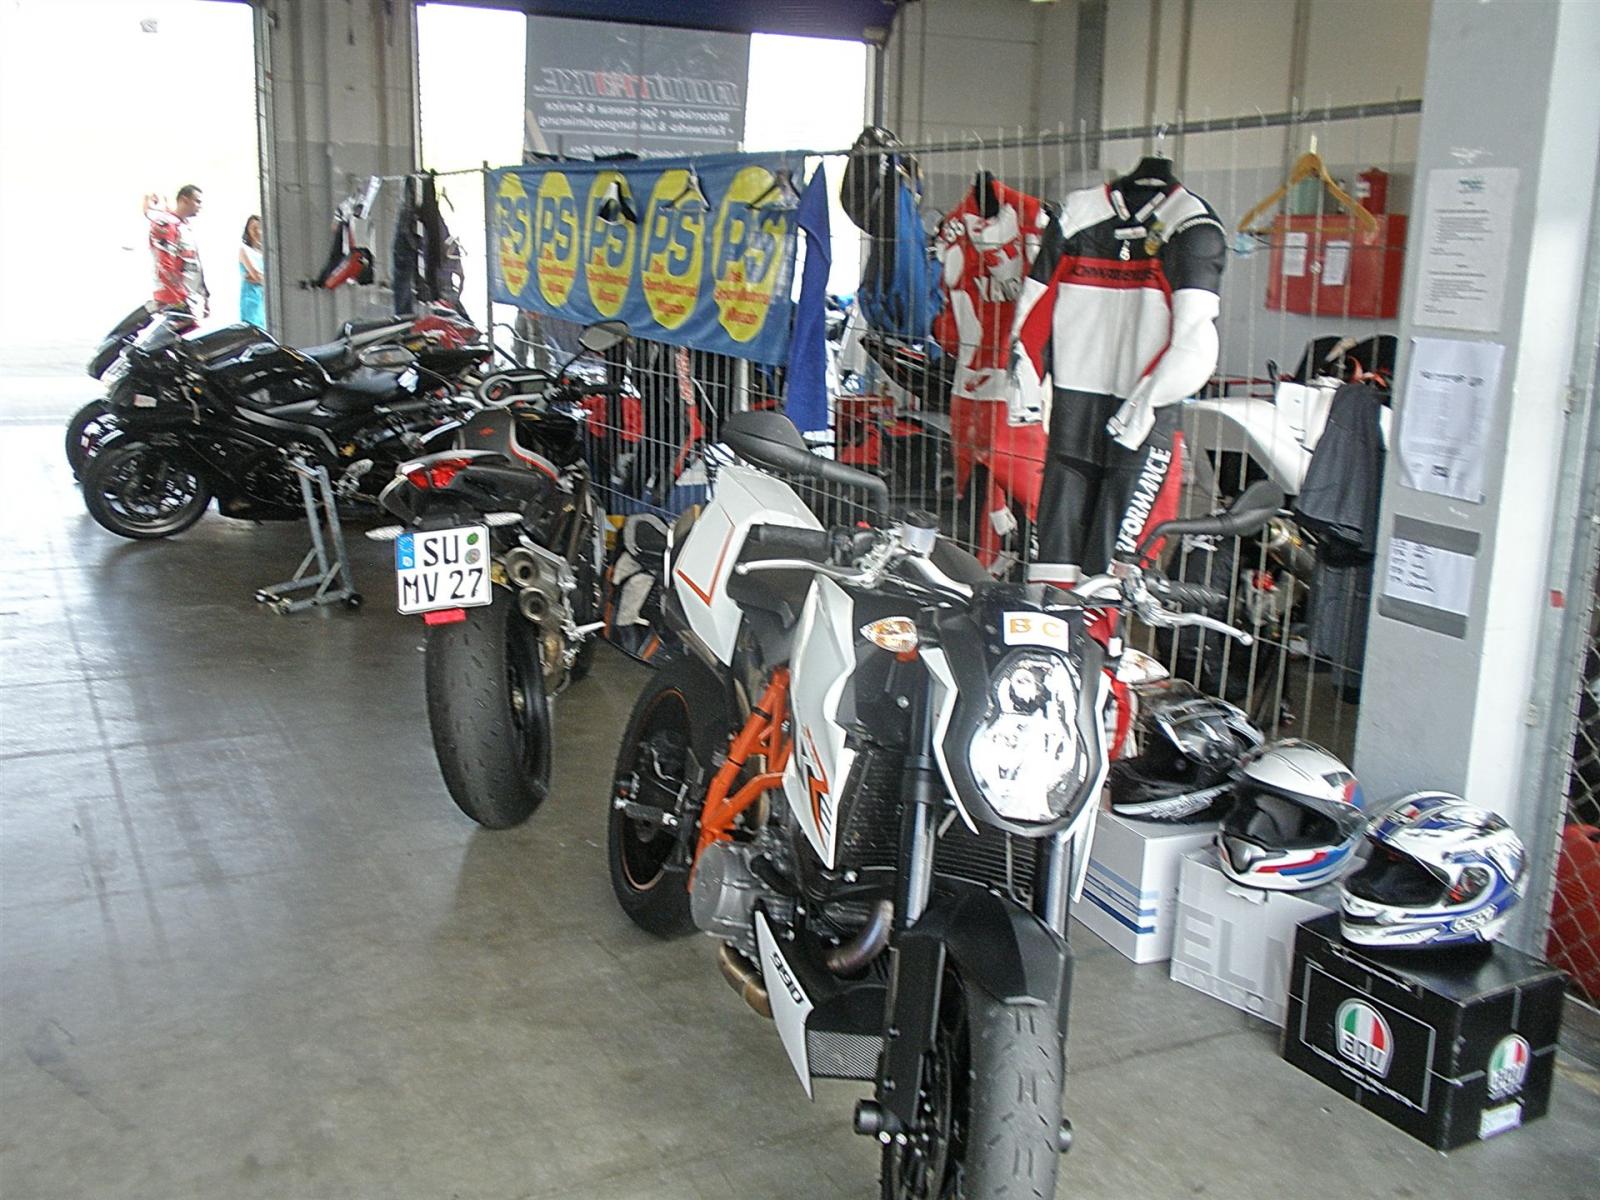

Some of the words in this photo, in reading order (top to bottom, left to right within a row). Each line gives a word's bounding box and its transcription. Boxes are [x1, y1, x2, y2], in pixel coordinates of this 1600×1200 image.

[540, 197, 575, 261] PS
[588, 196, 632, 268] PS
[645, 199, 700, 276] PS
[423, 535, 459, 567] SU
[403, 571, 438, 606] MV
[449, 568, 483, 600] 27
[770, 952, 804, 1005] 990
